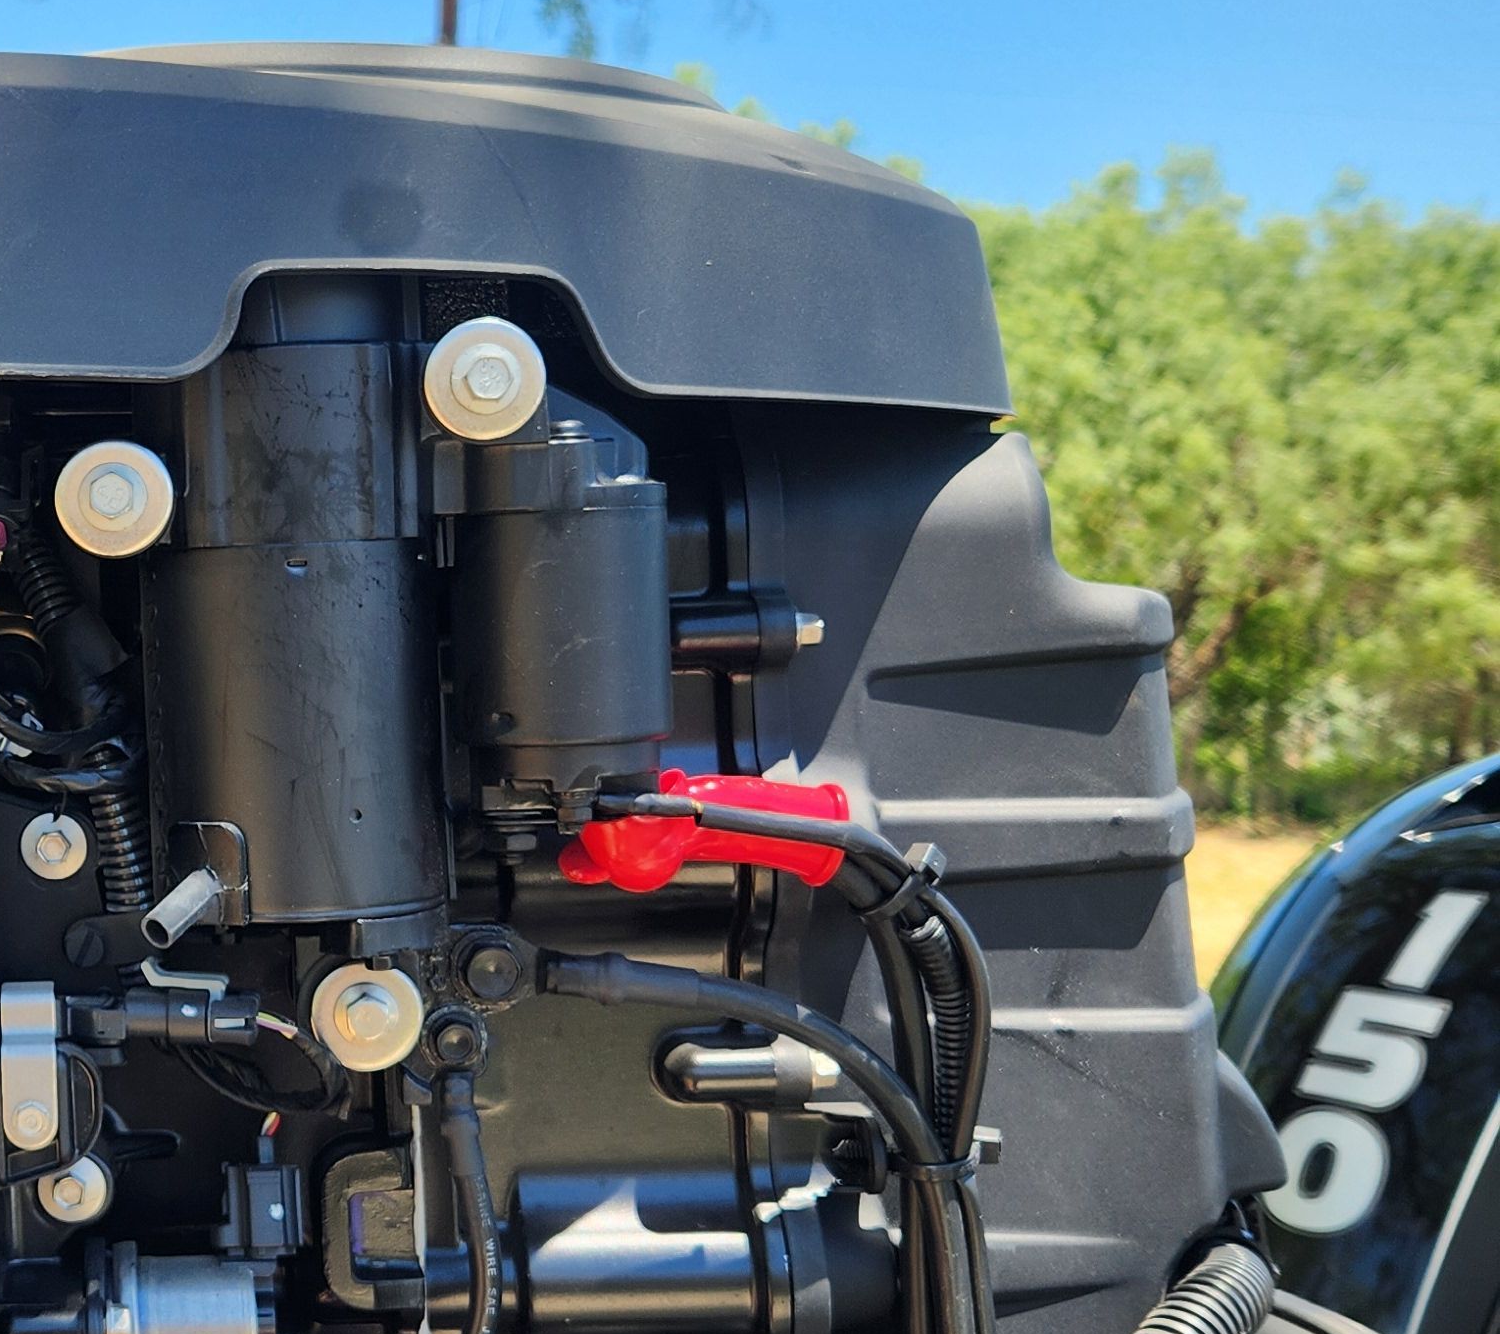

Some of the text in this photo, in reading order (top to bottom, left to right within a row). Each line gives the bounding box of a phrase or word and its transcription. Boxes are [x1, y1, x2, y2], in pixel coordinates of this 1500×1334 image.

[1260, 889, 1490, 1236] 150
[485, 1237, 497, 1276] WIRE
[485, 1287, 497, 1315] SAE
